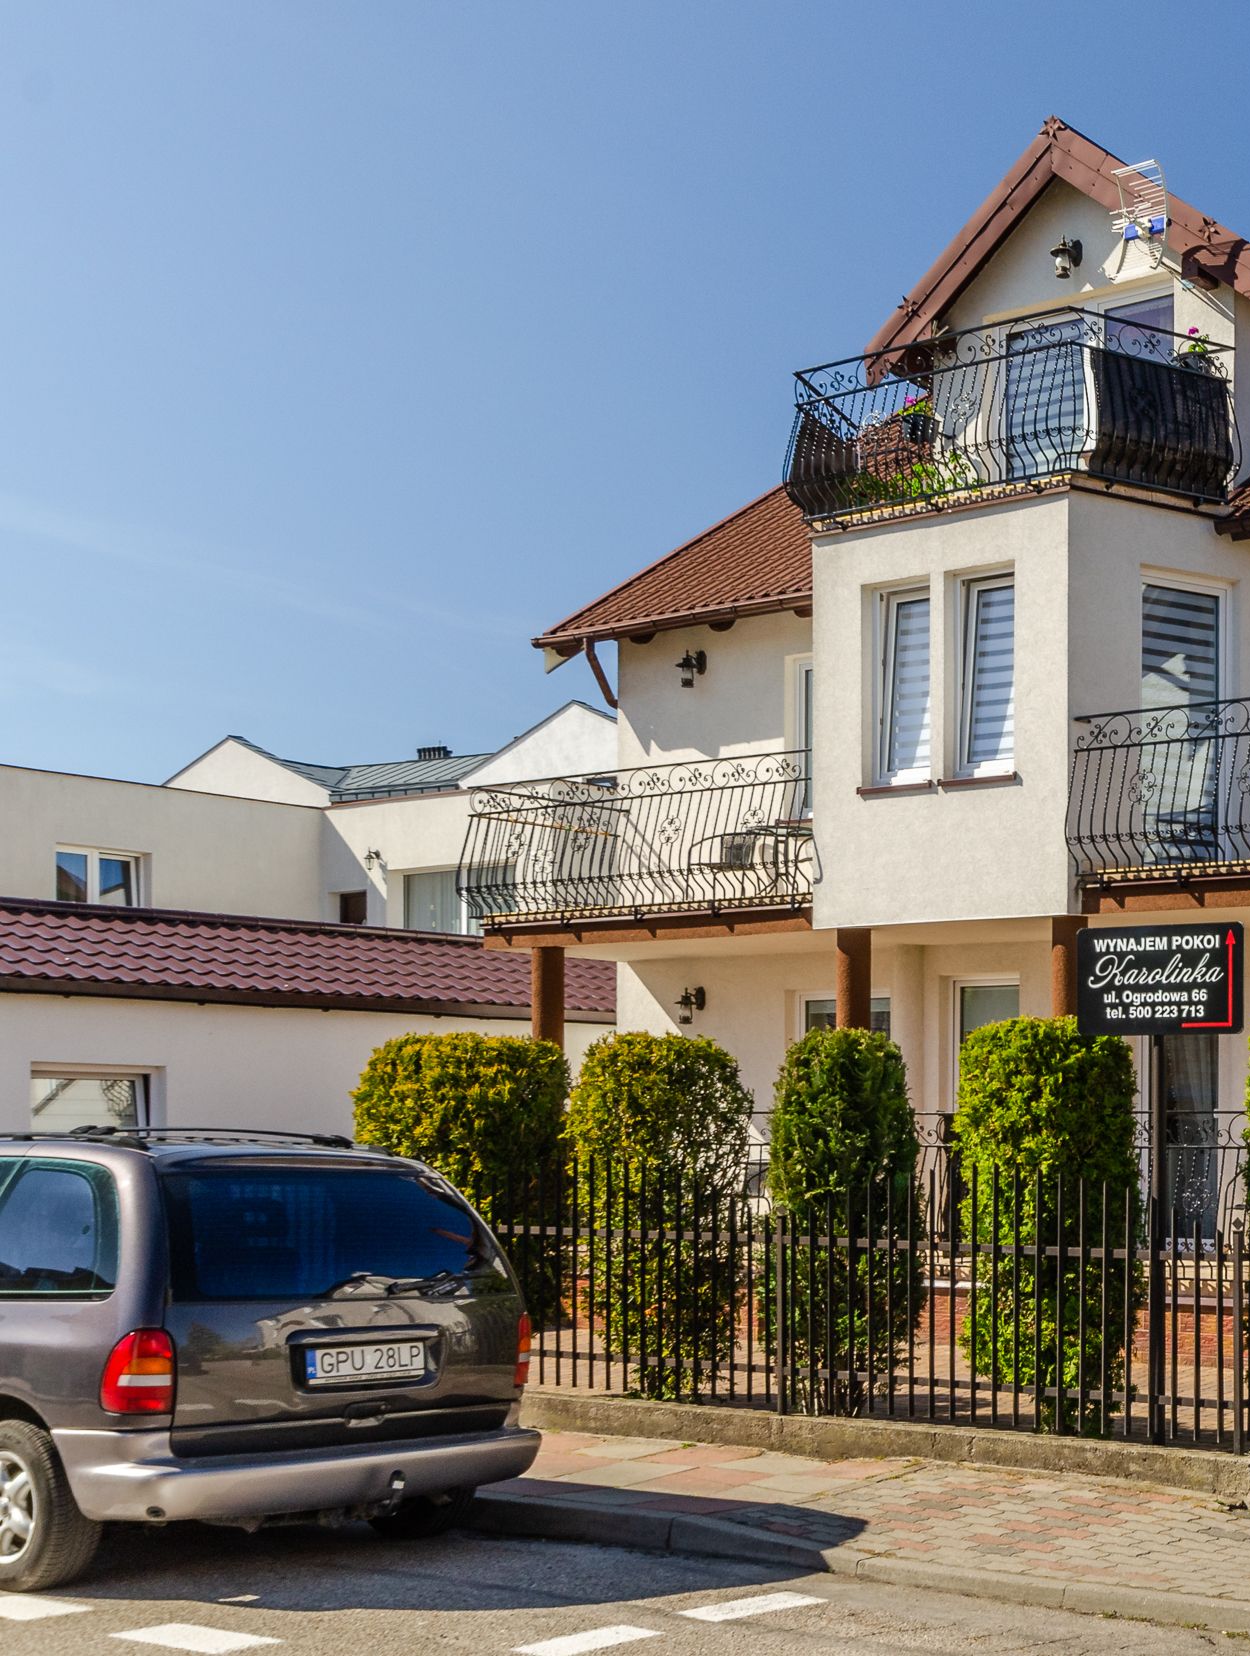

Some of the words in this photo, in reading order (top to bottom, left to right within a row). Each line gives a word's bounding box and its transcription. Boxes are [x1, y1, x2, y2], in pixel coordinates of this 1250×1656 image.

[1094, 937, 1168, 952] WYNAJEM
[1172, 935, 1220, 949] POKOI
[1088, 953, 1224, 988] Karolinka
[1103, 991, 1119, 1003] ul.
[1122, 989, 1188, 1005] Ogrodowa
[1191, 989, 1208, 1001] 66
[1106, 1007, 1126, 1018] tel.
[1129, 1006, 1151, 1018] 500
[1154, 1005, 1178, 1017] 223
[1181, 1005, 1204, 1017] 713
[320, 1350, 365, 1374] GPU
[374, 1345, 420, 1369] 28LP
